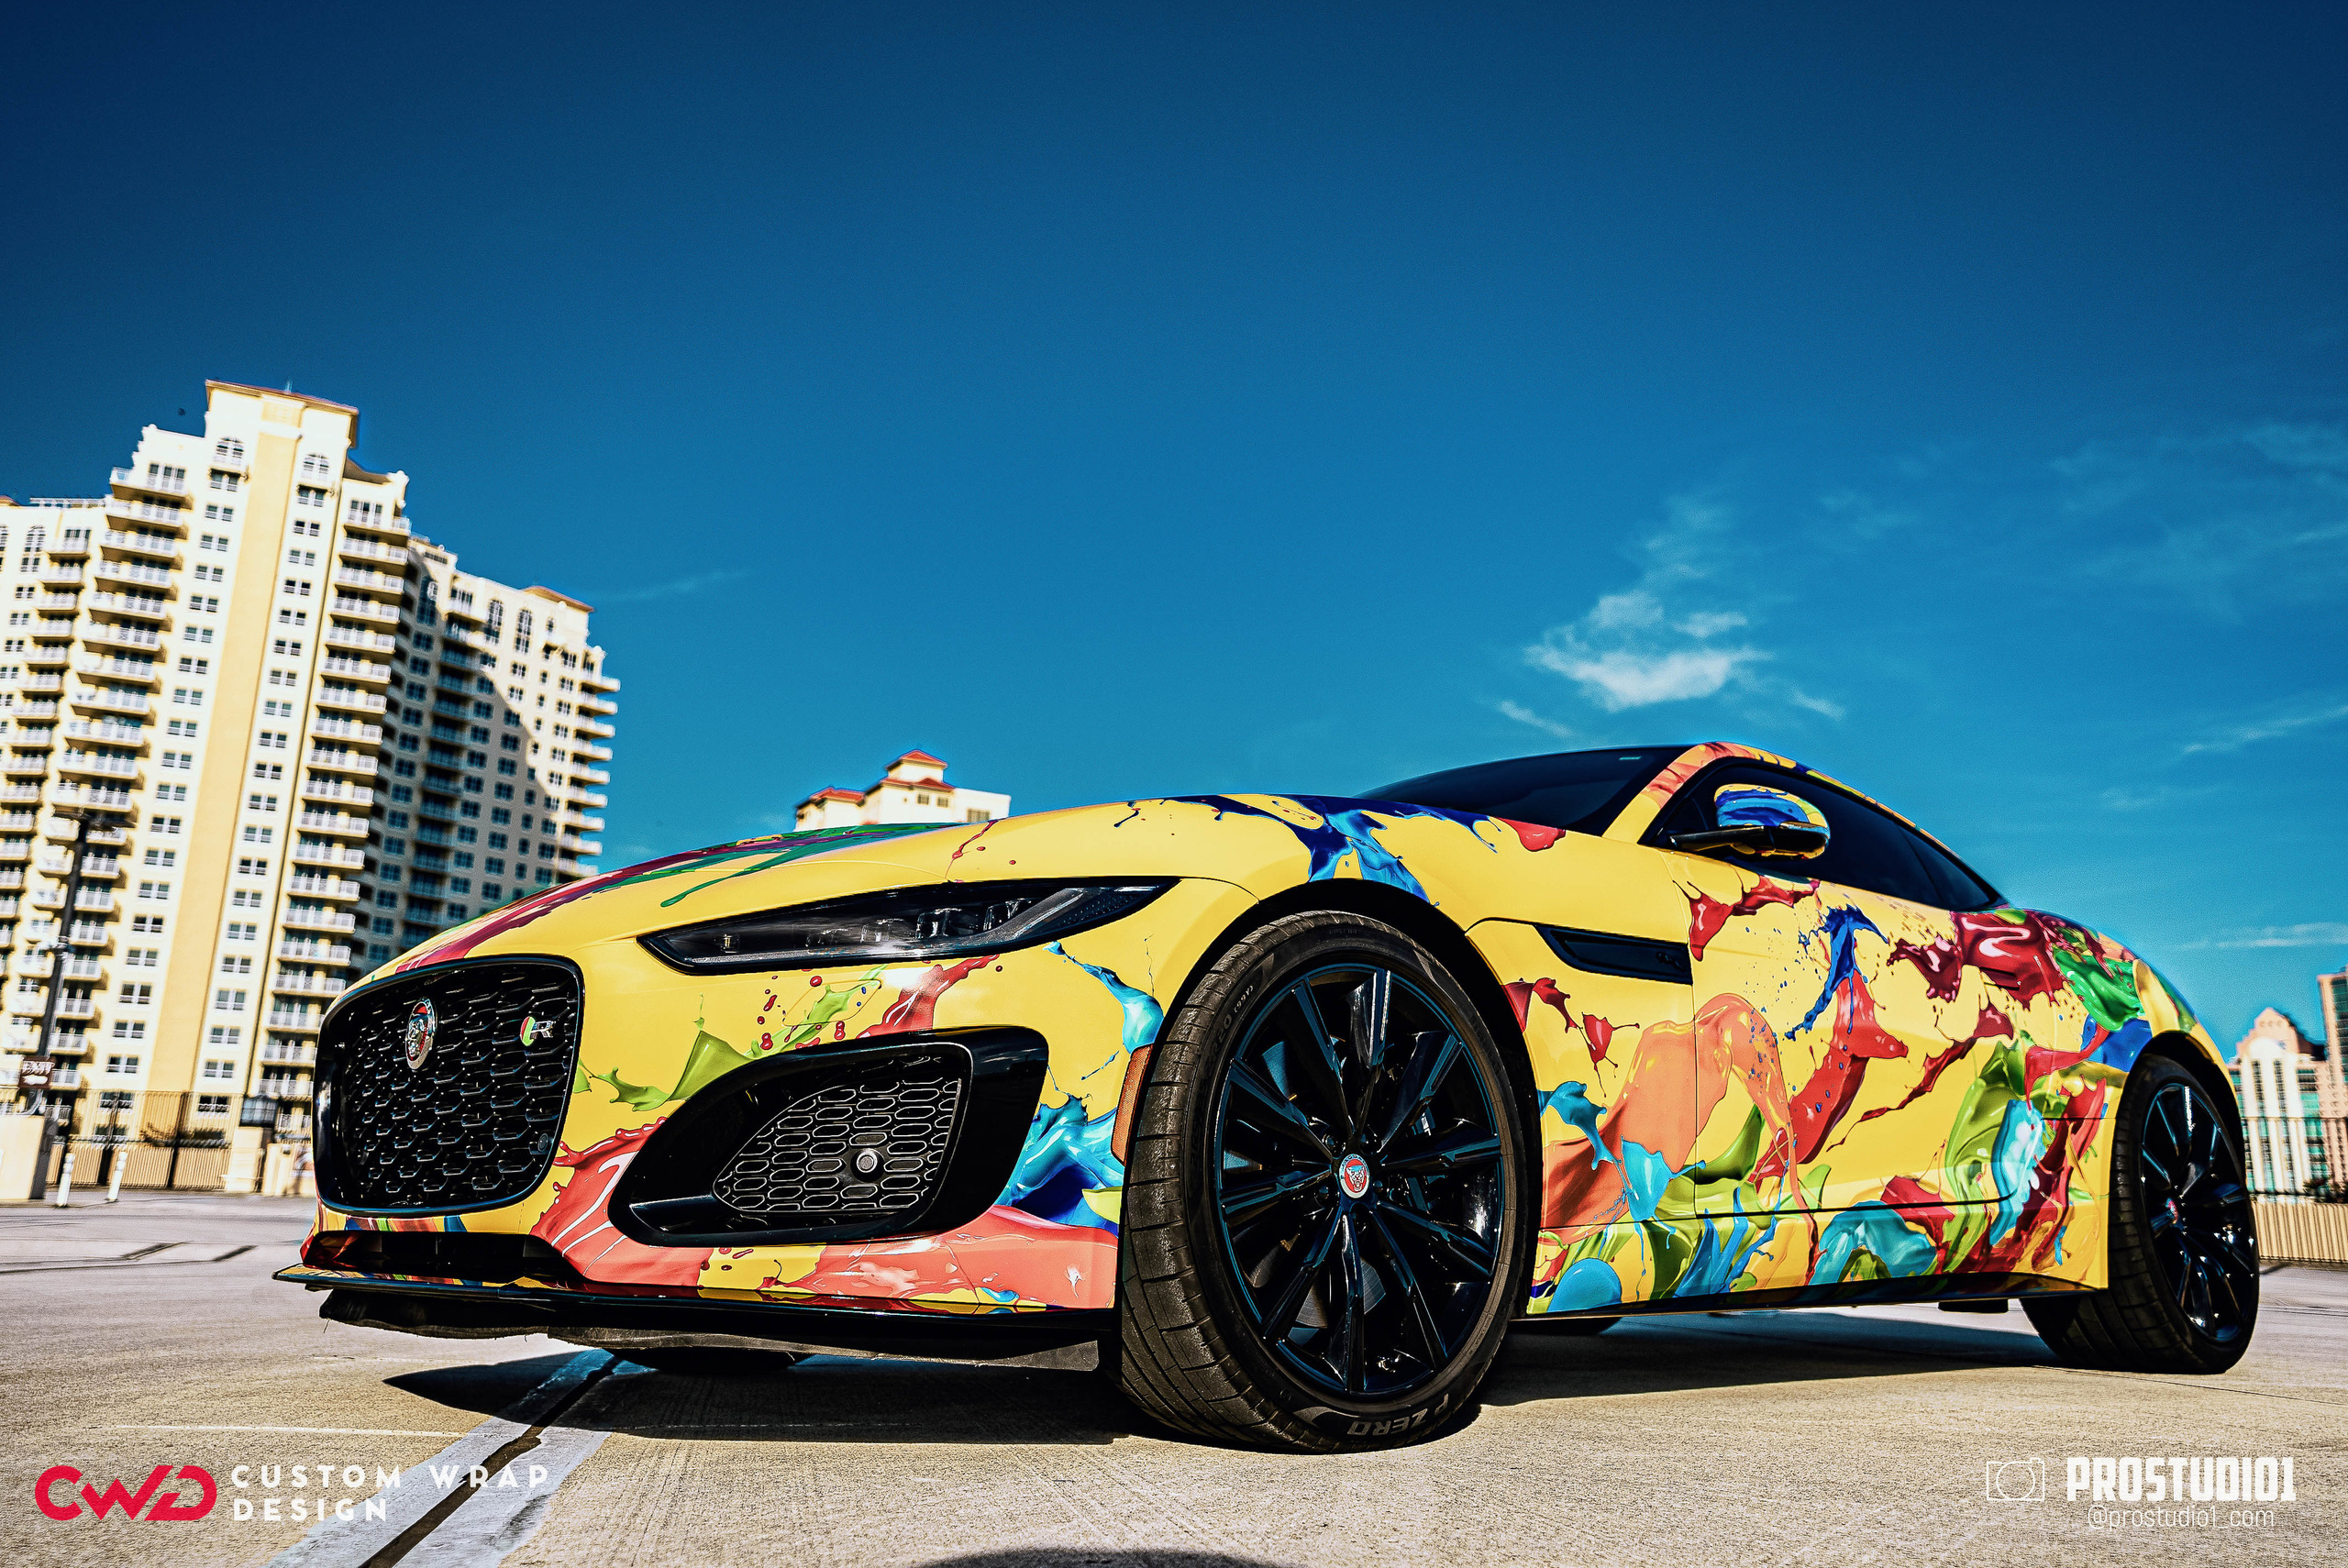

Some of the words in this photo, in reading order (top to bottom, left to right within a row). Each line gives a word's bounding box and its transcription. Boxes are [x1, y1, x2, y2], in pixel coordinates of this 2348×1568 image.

[1234, 985, 1254, 1013] (99Y)
[531, 1020, 555, 1040] R
[21, 1060, 55, 1075] EXIT
[1434, 1393, 1449, 1416] P
[1347, 1408, 1428, 1436] ZERO
